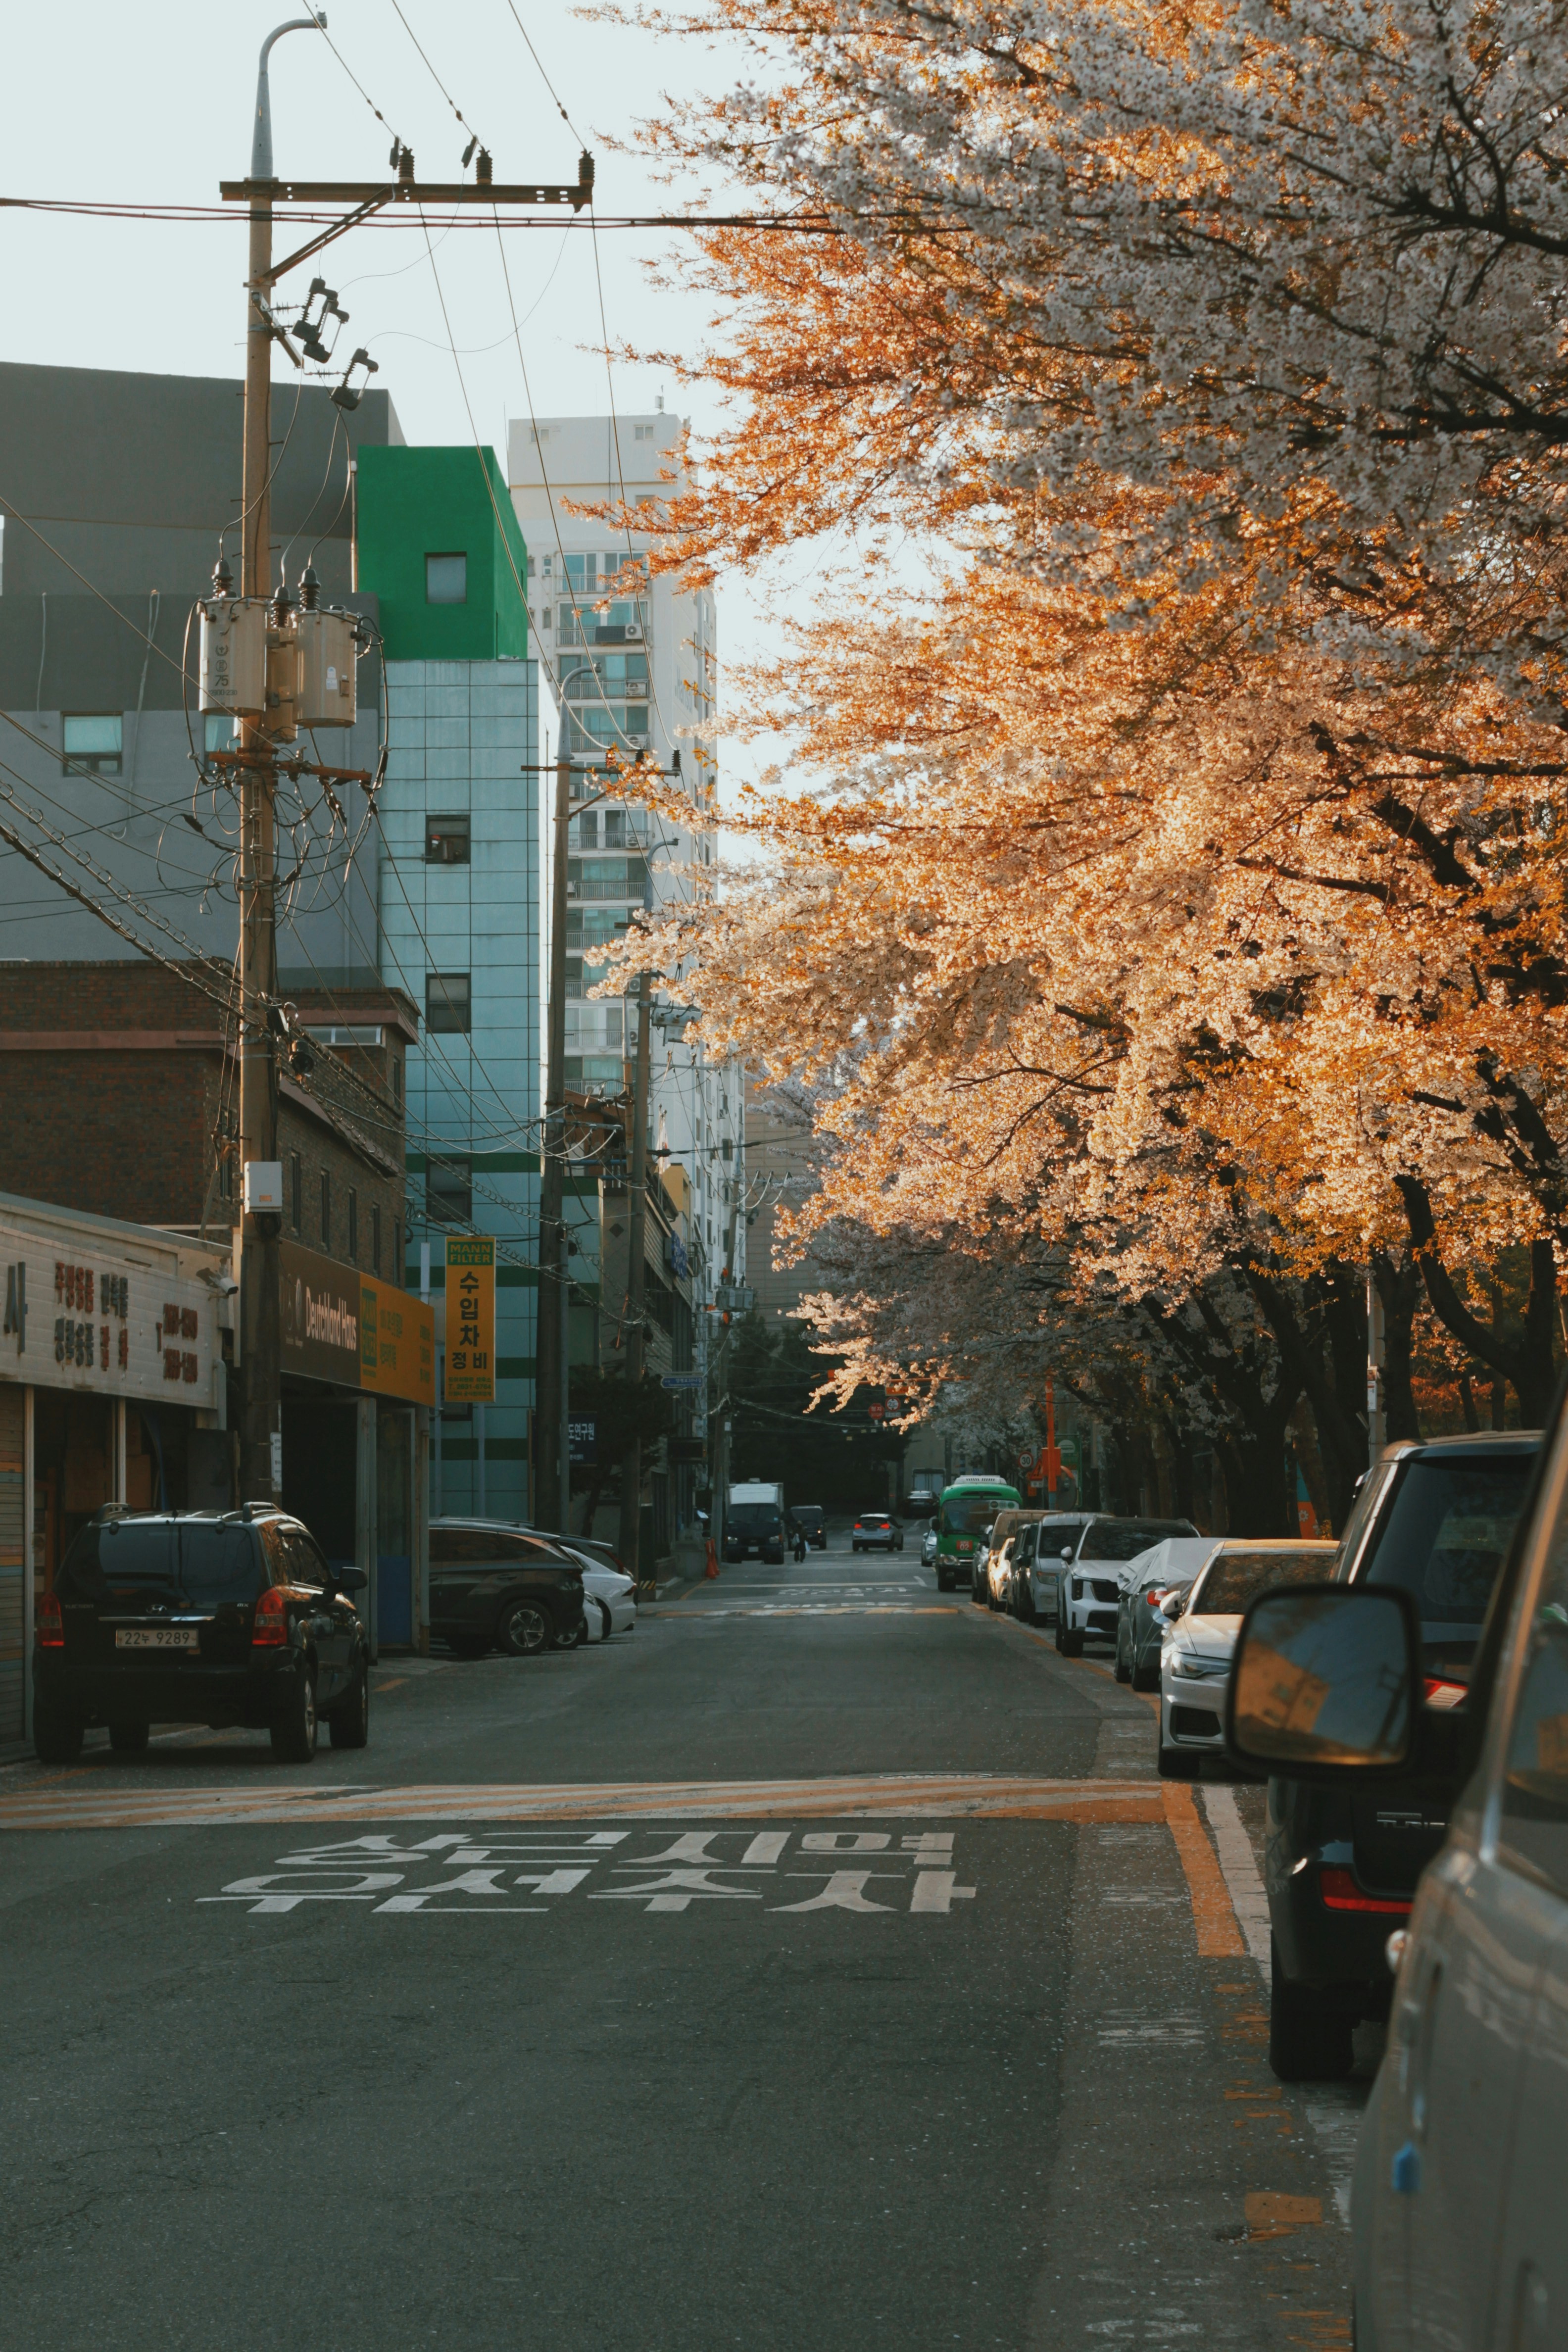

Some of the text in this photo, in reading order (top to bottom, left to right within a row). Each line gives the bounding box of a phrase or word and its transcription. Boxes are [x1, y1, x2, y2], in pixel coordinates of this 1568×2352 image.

[215, 675, 229, 686] 75
[450, 1244, 490, 1253] MANN
[450, 1254, 490, 1263] FILTER
[55, 1262, 94, 1313] 주방용품
[342, 1299, 356, 1351] Haus
[459, 1271, 480, 1347] 수입차
[55, 1318, 94, 1366] 생활용품
[1021, 1456, 1030, 1465] 30
[125, 1632, 190, 1645] 22누 9289
[272, 1831, 954, 1865] 상근지역
[194, 1868, 977, 1913] 우선주차
